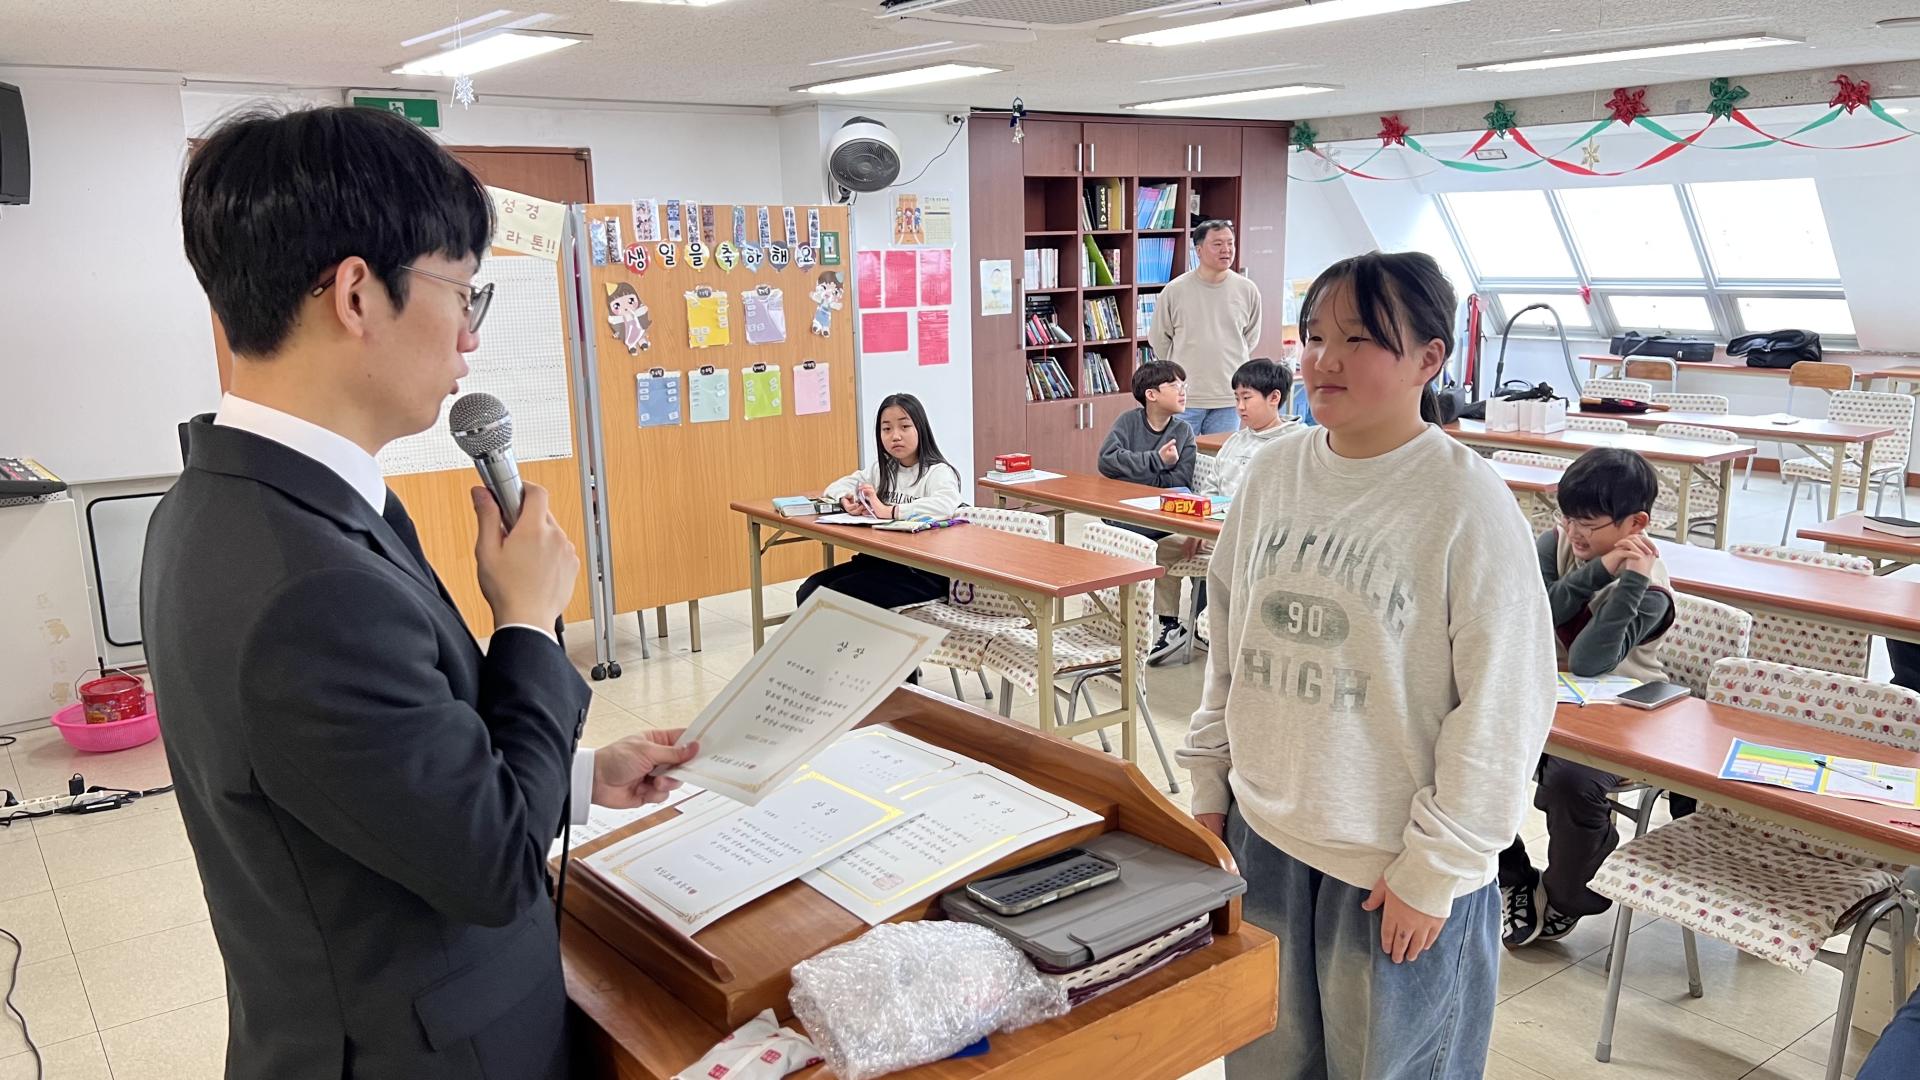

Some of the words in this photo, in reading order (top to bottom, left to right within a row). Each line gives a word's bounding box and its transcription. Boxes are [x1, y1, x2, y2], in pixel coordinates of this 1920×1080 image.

[506, 230, 556, 254] 라톤!!
[1287, 601, 1323, 638] 90
[1241, 648, 1371, 712] HIGH
